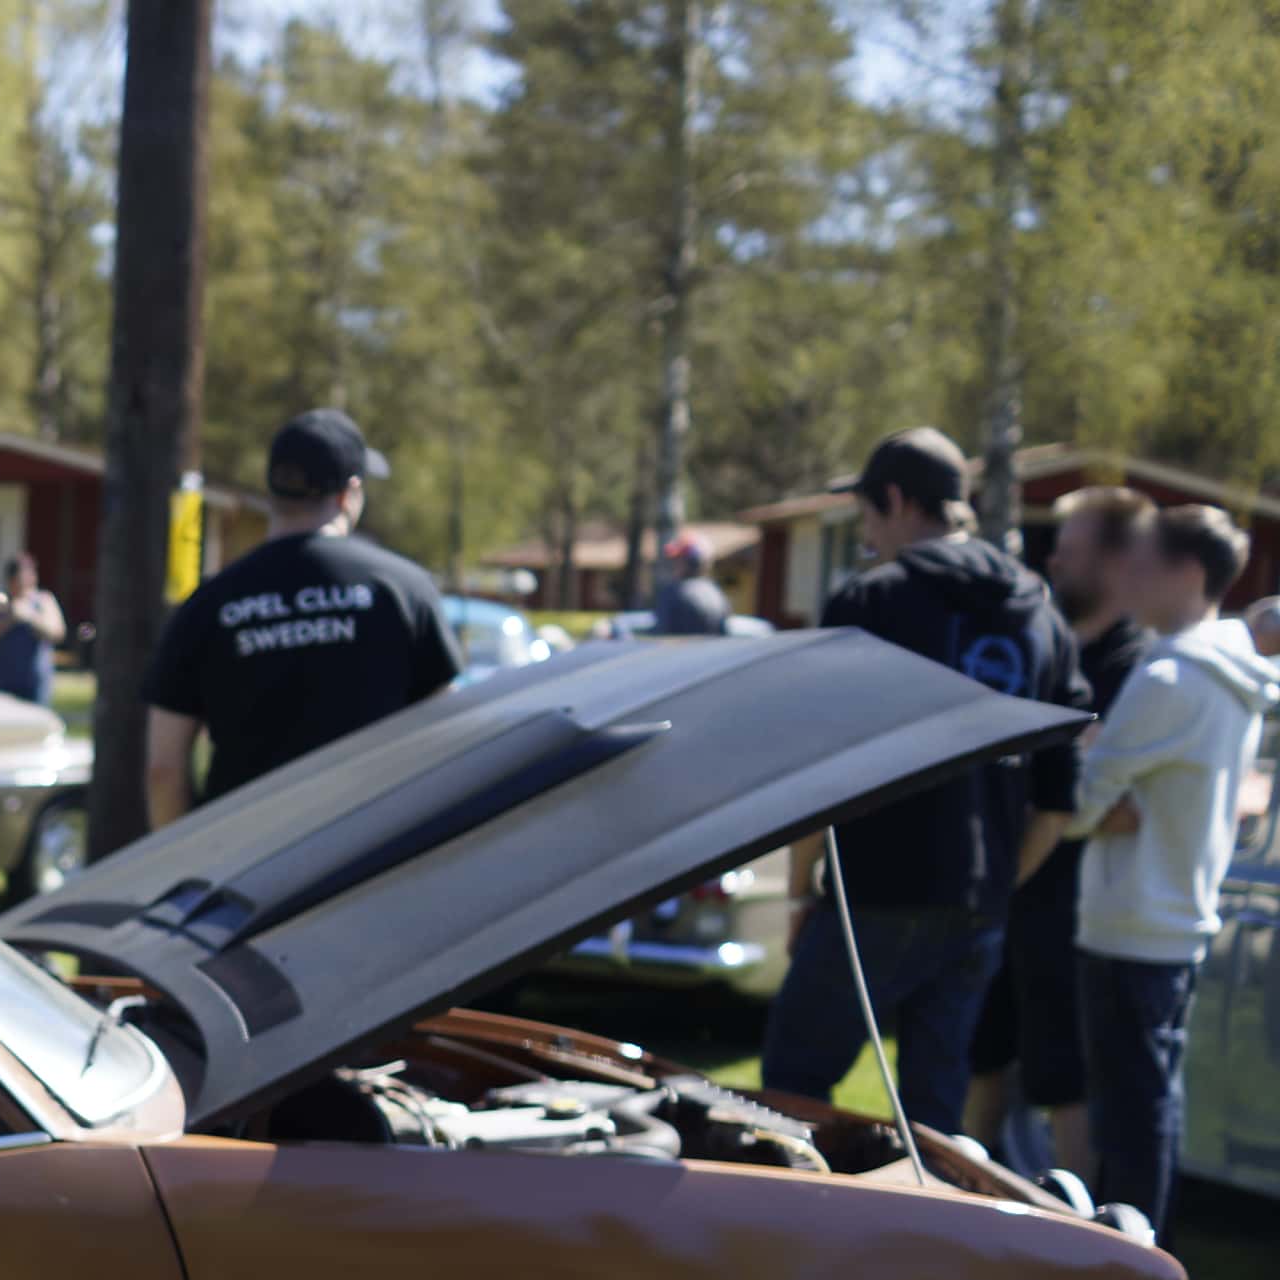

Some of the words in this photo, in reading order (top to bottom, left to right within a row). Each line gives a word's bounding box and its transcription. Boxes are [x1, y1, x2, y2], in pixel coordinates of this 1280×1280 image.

[219, 593, 289, 625] OPEL
[296, 583, 373, 611] CLUB
[235, 616, 356, 655] SWEDEN
